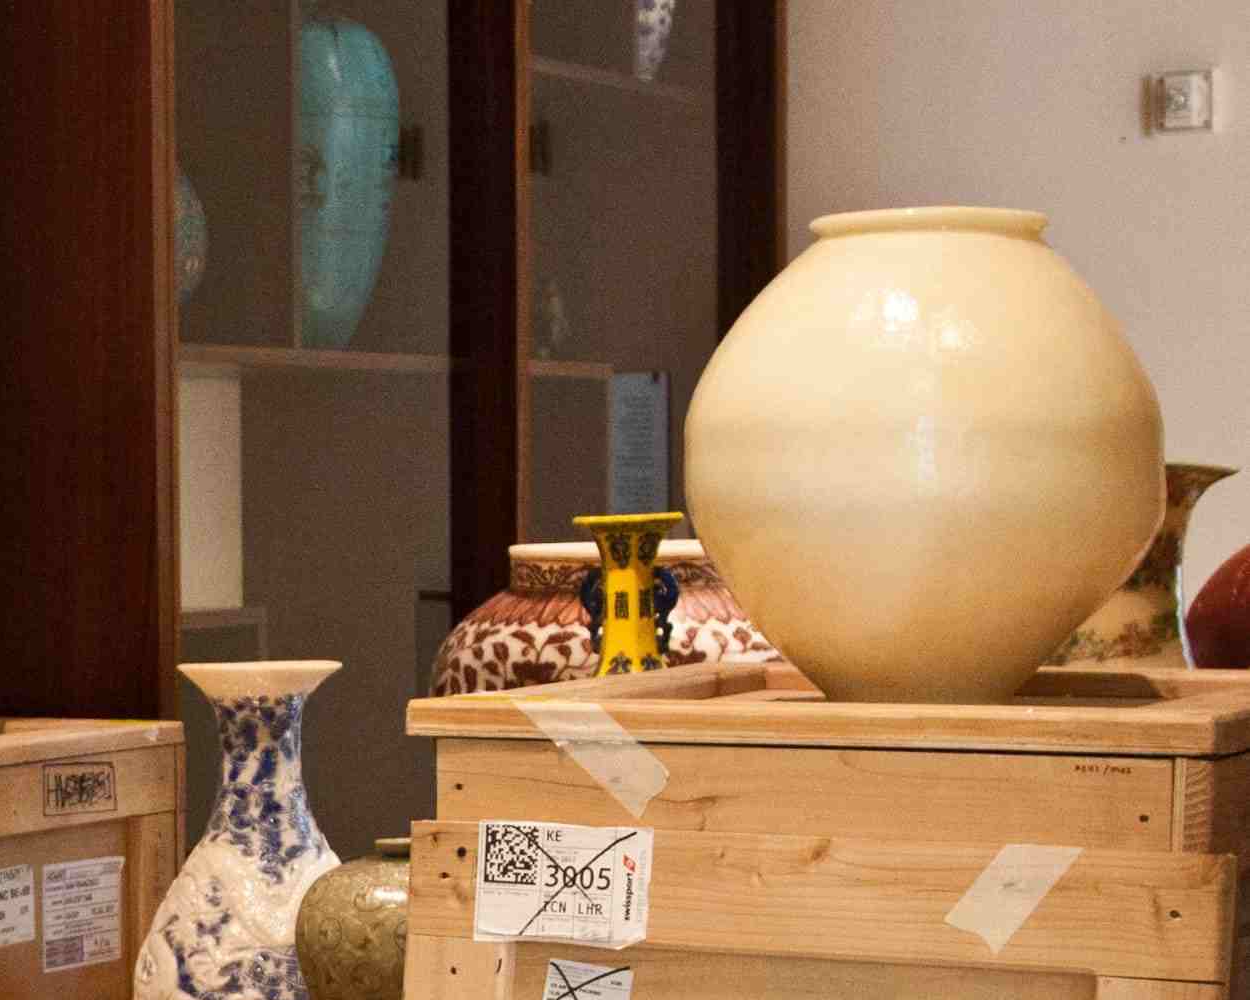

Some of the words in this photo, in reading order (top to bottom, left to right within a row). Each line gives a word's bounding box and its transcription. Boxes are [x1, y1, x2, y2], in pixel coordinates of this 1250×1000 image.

[546, 830, 563, 842] KE
[544, 864, 611, 890] 3005
[623, 872, 634, 920] swissport
[577, 903, 603, 915] LHR
